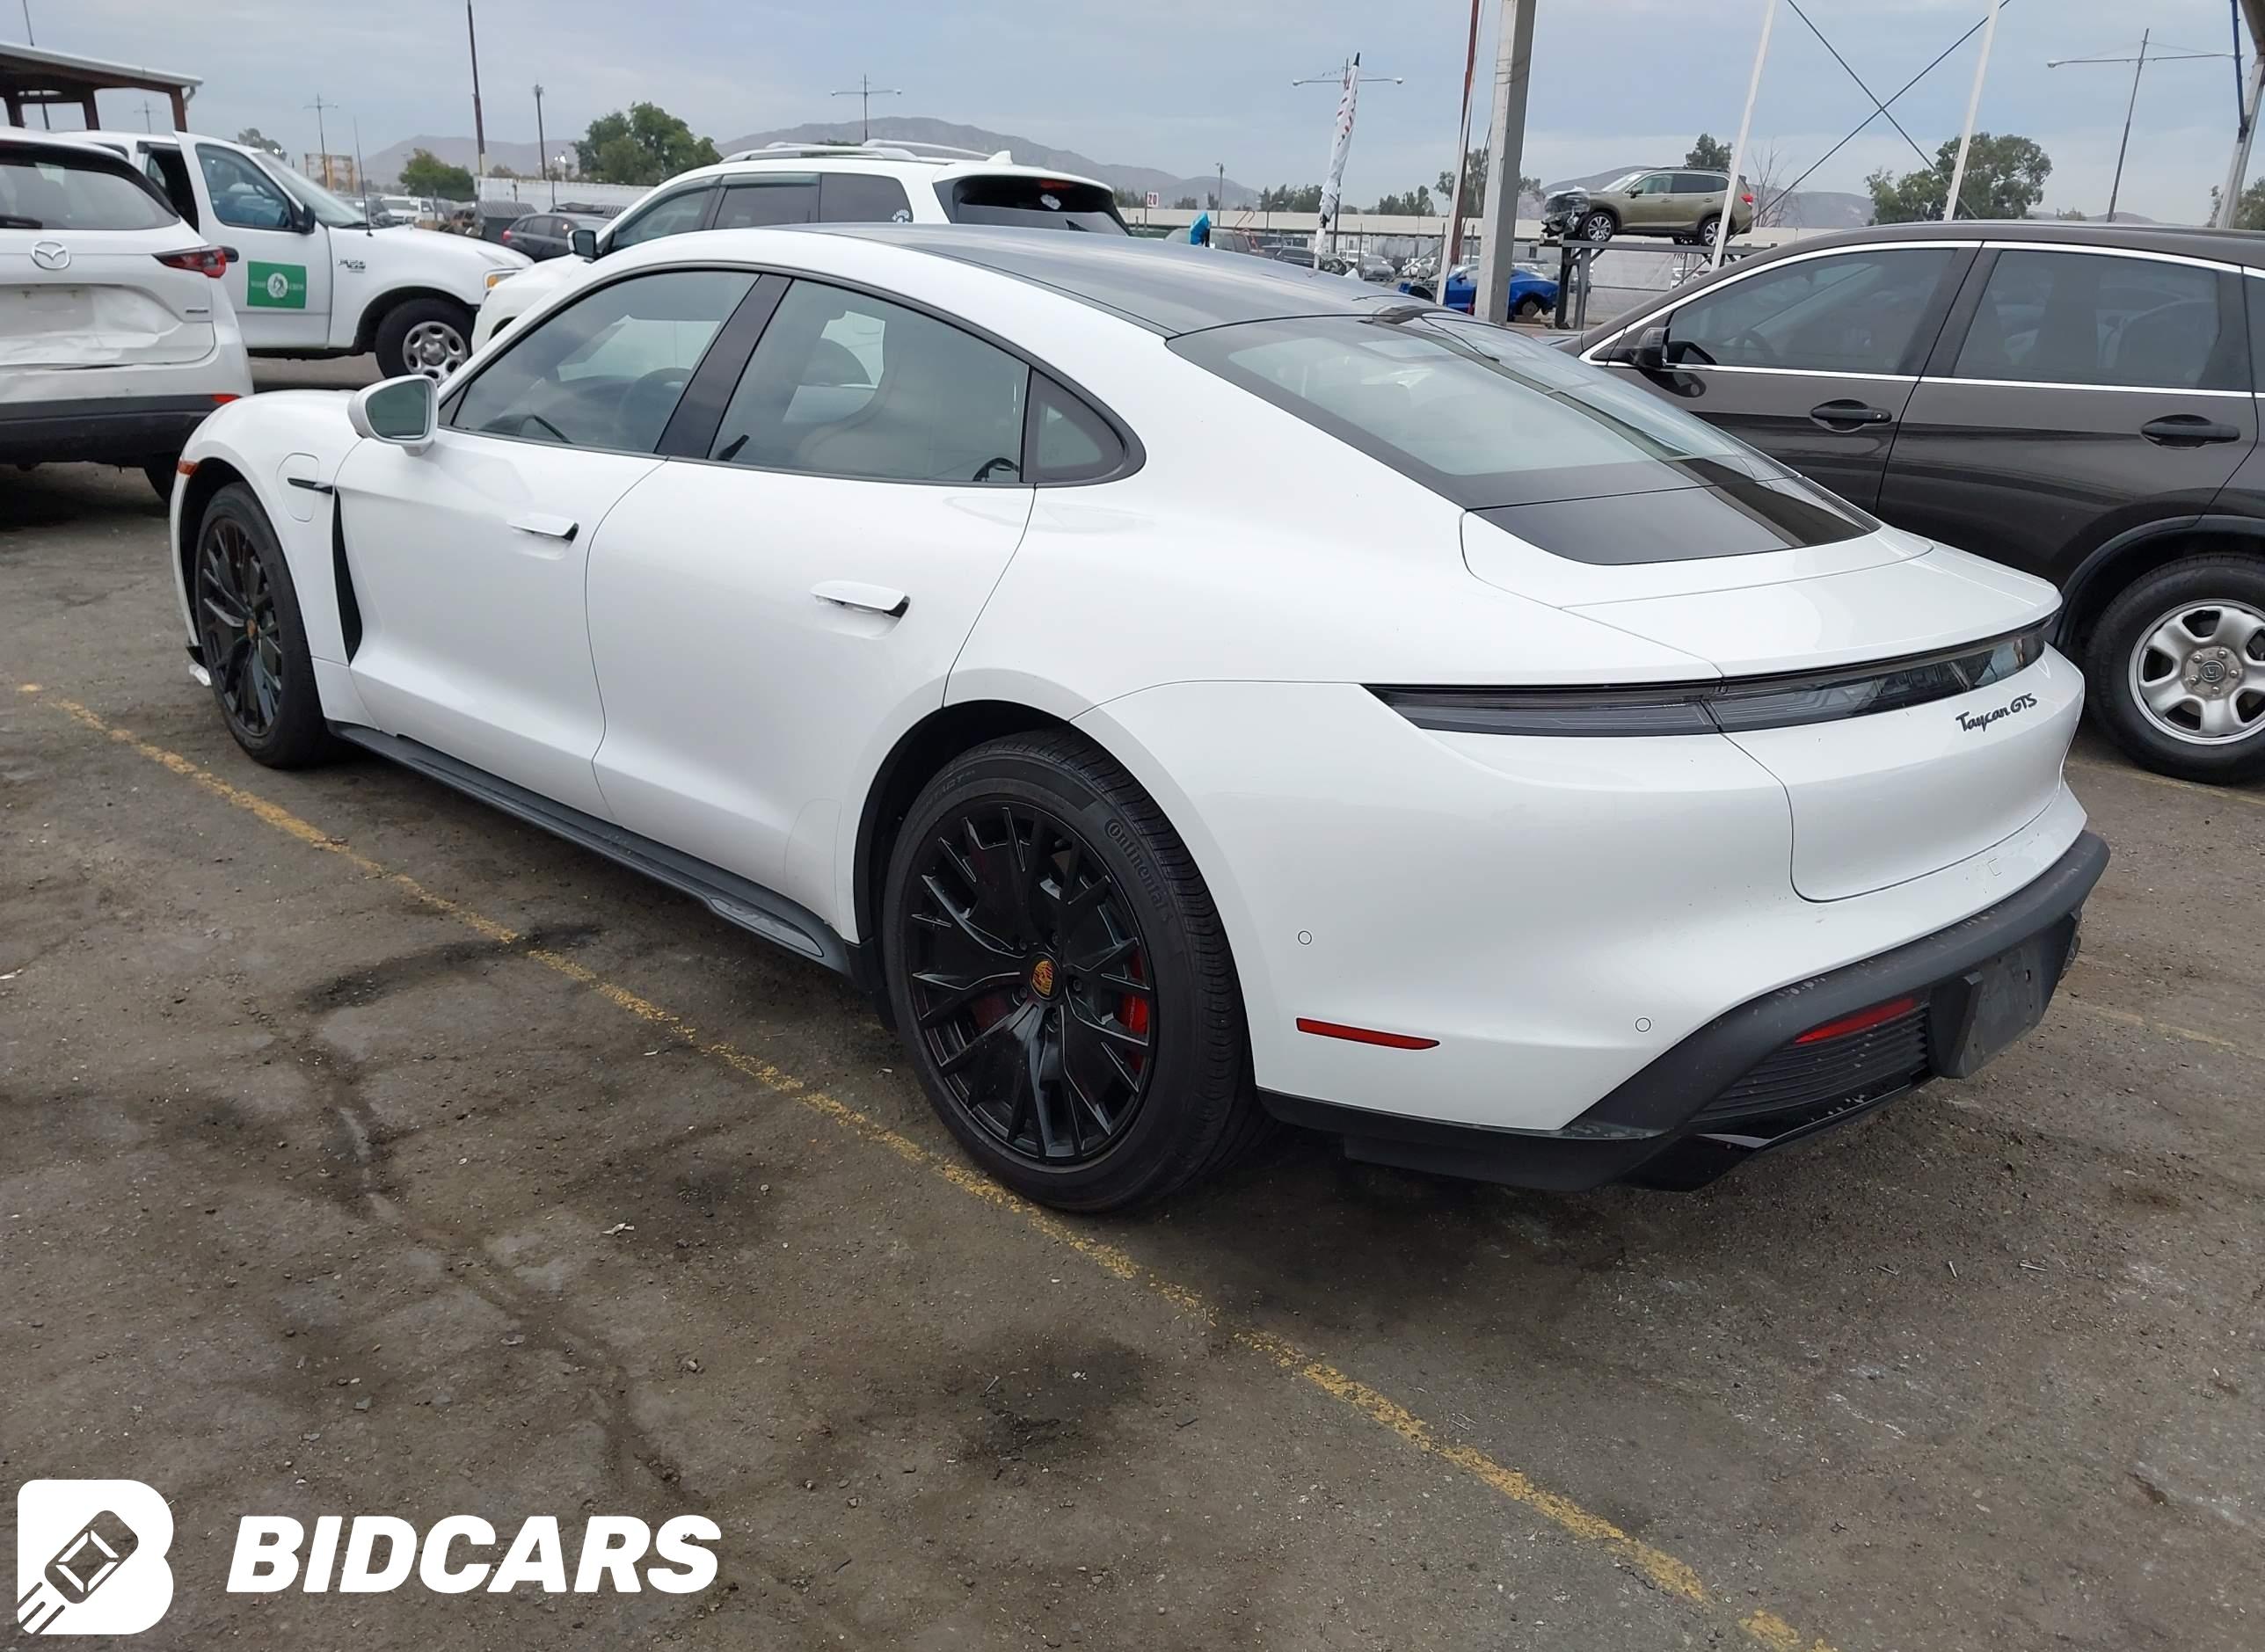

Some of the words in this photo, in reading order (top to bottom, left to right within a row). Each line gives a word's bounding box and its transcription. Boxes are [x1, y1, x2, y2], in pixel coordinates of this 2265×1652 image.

[1147, 193, 1158, 206] 20
[1955, 706, 2011, 732] Taycan
[2010, 692, 2038, 714] GTS
